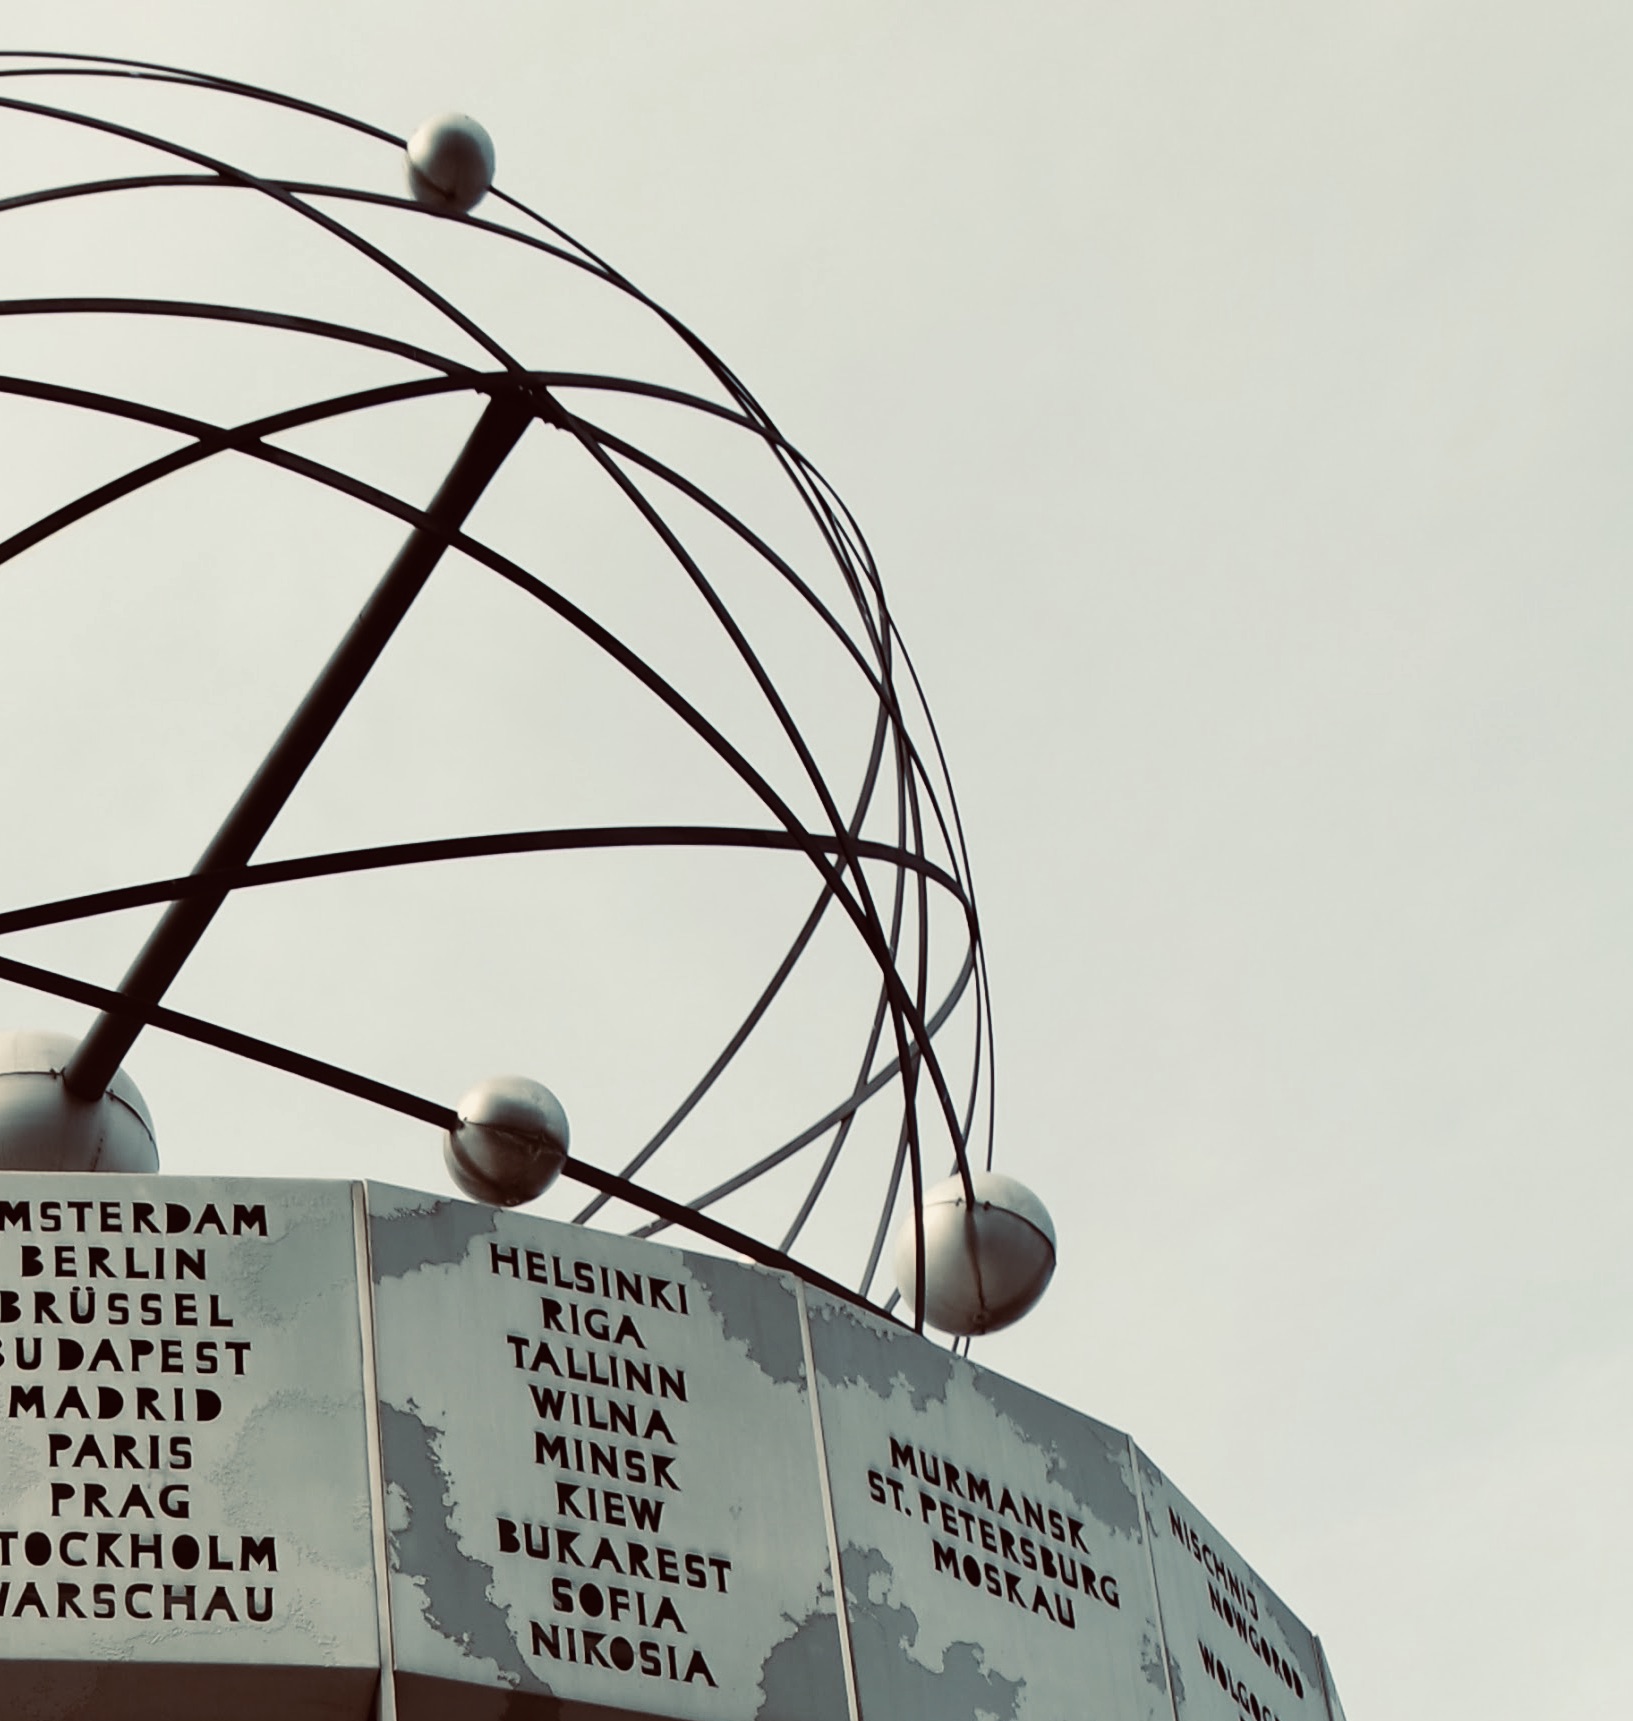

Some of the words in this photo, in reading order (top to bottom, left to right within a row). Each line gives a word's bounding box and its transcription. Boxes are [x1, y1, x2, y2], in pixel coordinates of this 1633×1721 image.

[21, 1245, 206, 1281] BERLIN
[489, 1242, 689, 1315] HELSINKI
[0, 1286, 234, 1328] BRÜSSEL
[540, 1296, 646, 1350] RIGA
[506, 1334, 688, 1403] TALLINN
[8, 1385, 222, 1422] MADRID
[528, 1383, 677, 1445] WILNA
[48, 1433, 192, 1470] PARIS
[535, 1431, 681, 1492] MINSK
[50, 1482, 190, 1519] PRAG
[555, 1481, 665, 1533] KIEW
[889, 1436, 1090, 1555] MURMANSK
[496, 1517, 732, 1594] BUKAREST
[867, 1469, 912, 1517] ST.
[919, 1491, 1120, 1610] PETERSBURG
[1168, 1506, 1259, 1622] NISCHNIJ
[551, 1577, 688, 1634] SOFIA
[932, 1538, 1076, 1630] MOSKAU
[529, 1620, 719, 1688] NIKOSIA
[1207, 1581, 1304, 1700] NOWGOROD
